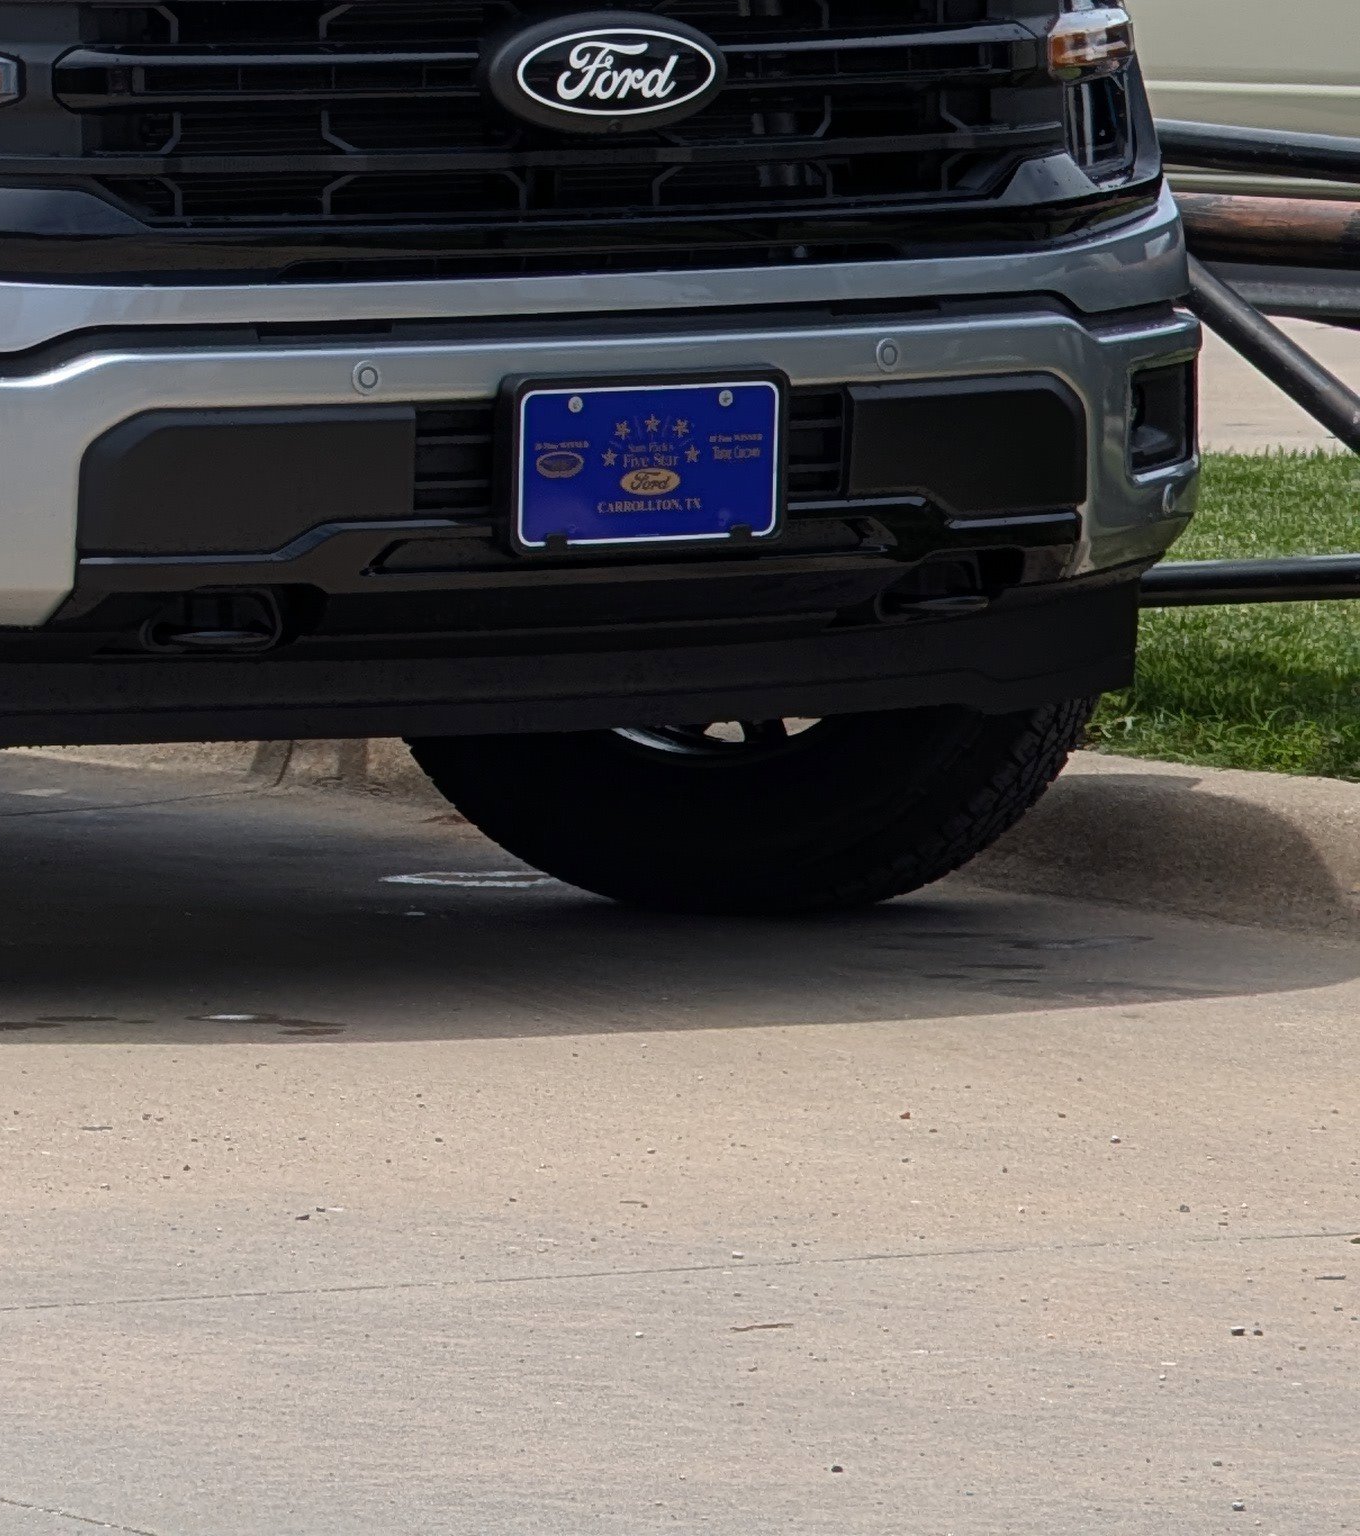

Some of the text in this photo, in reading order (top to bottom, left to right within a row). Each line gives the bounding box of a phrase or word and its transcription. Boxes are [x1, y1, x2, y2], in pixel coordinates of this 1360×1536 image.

[556, 41, 679, 101] Ford
[630, 471, 671, 490] Ford
[684, 497, 702, 510] TX
